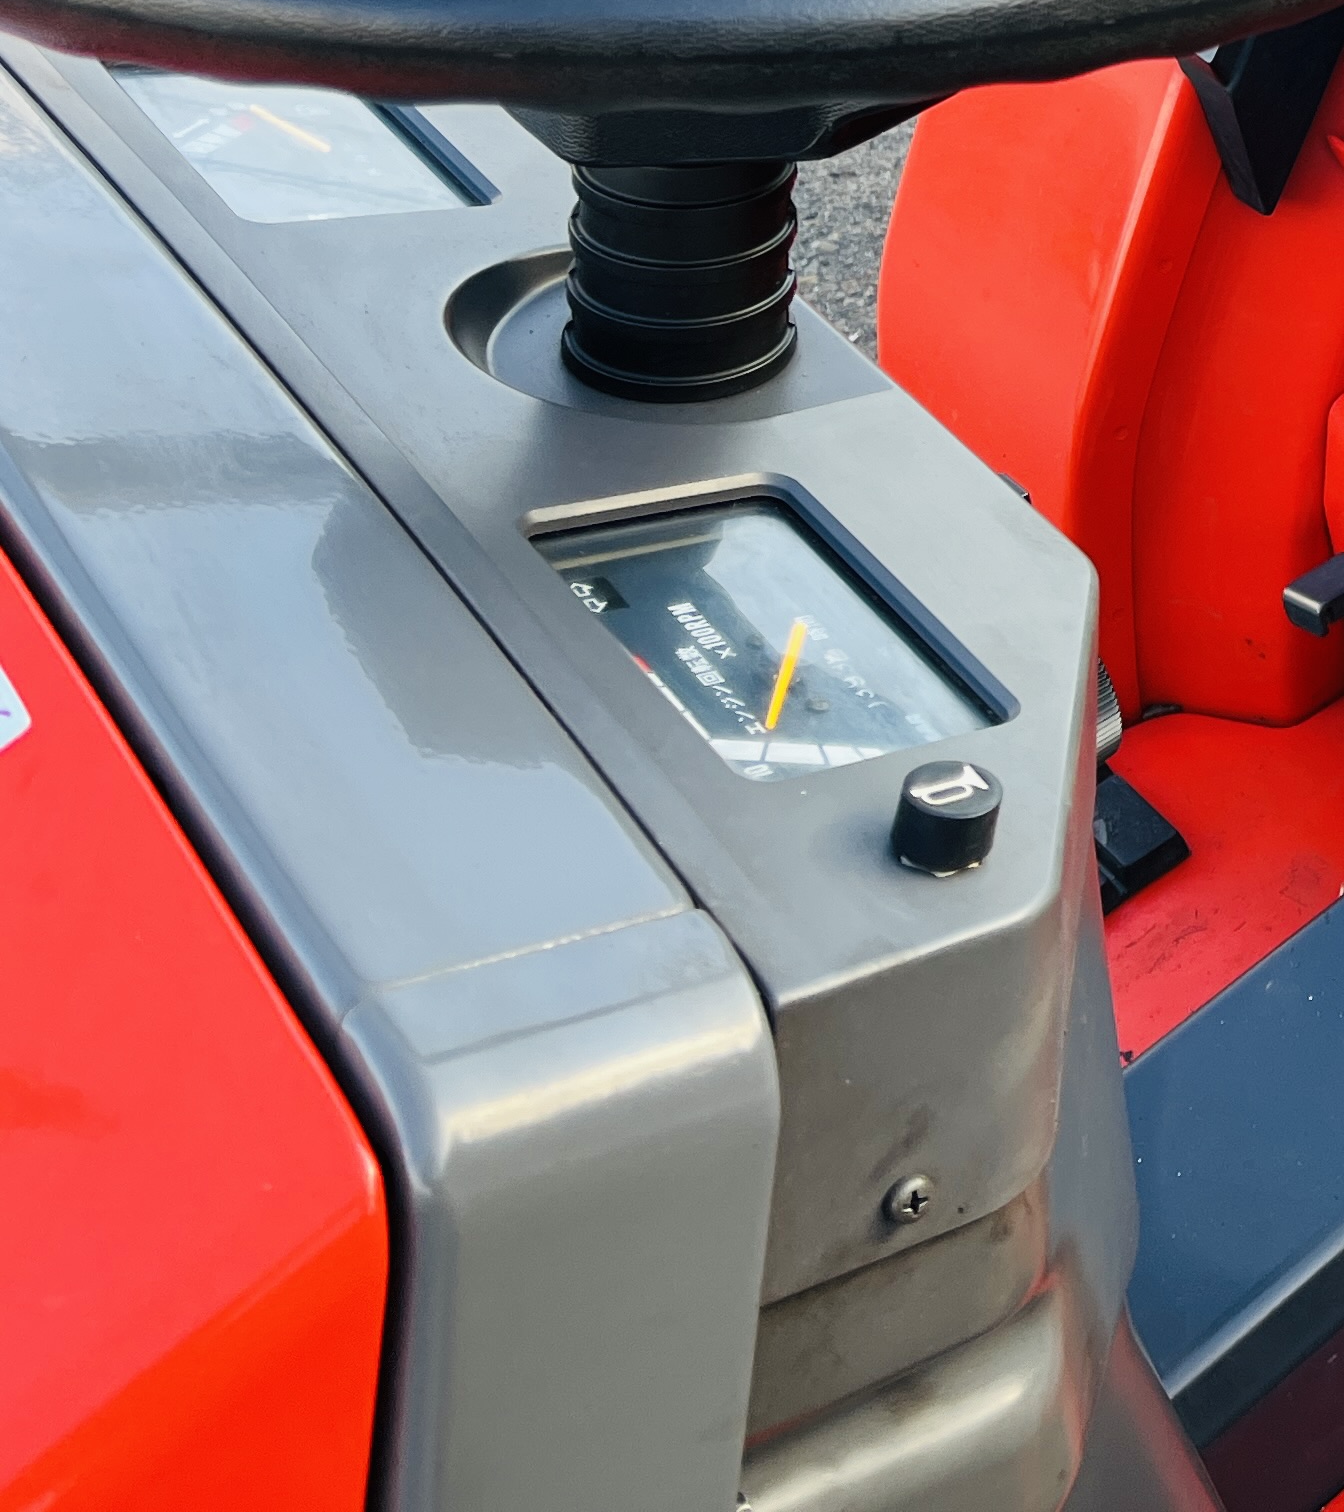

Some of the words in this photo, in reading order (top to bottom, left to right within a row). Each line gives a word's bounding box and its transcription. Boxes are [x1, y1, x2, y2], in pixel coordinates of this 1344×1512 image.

[675, 645, 767, 735] エンジン回転数
